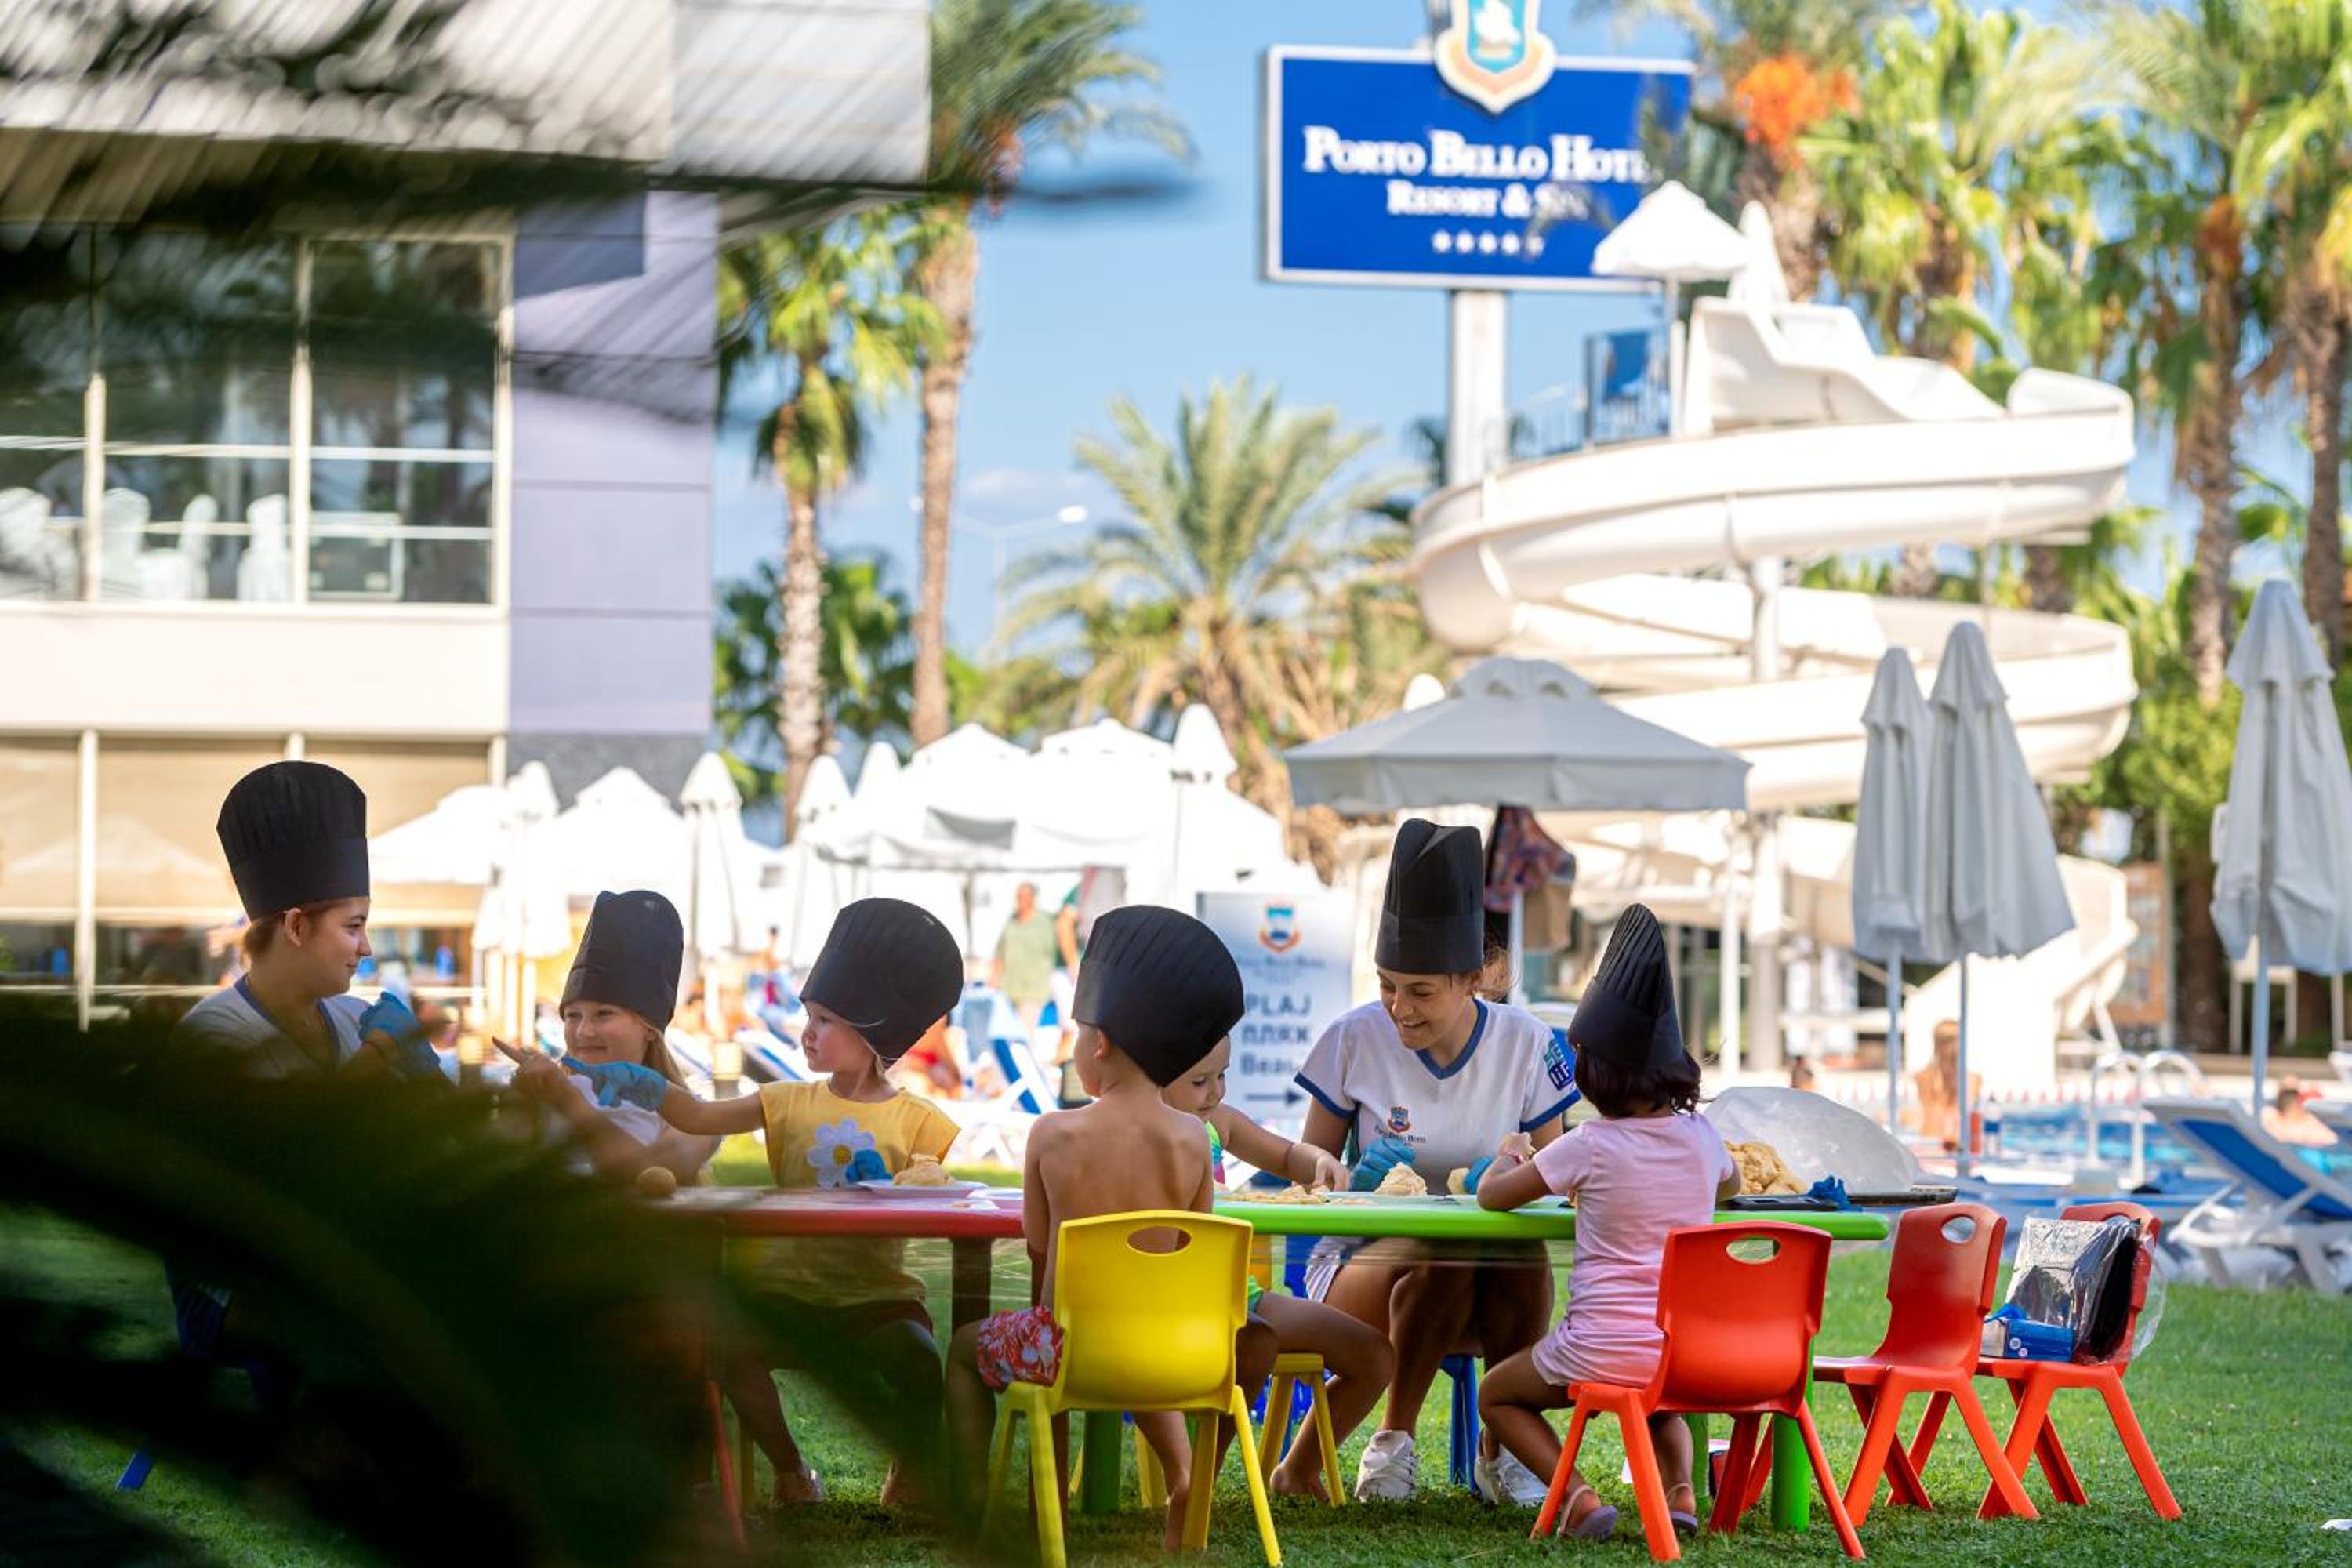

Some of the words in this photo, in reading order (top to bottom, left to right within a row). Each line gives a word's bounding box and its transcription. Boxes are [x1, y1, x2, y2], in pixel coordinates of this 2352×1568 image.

[1302, 125, 1426, 174] PORTO
[1428, 129, 1548, 179] BELLO
[1501, 183, 1531, 218] &
[1245, 993, 1311, 1016] PLAJ
